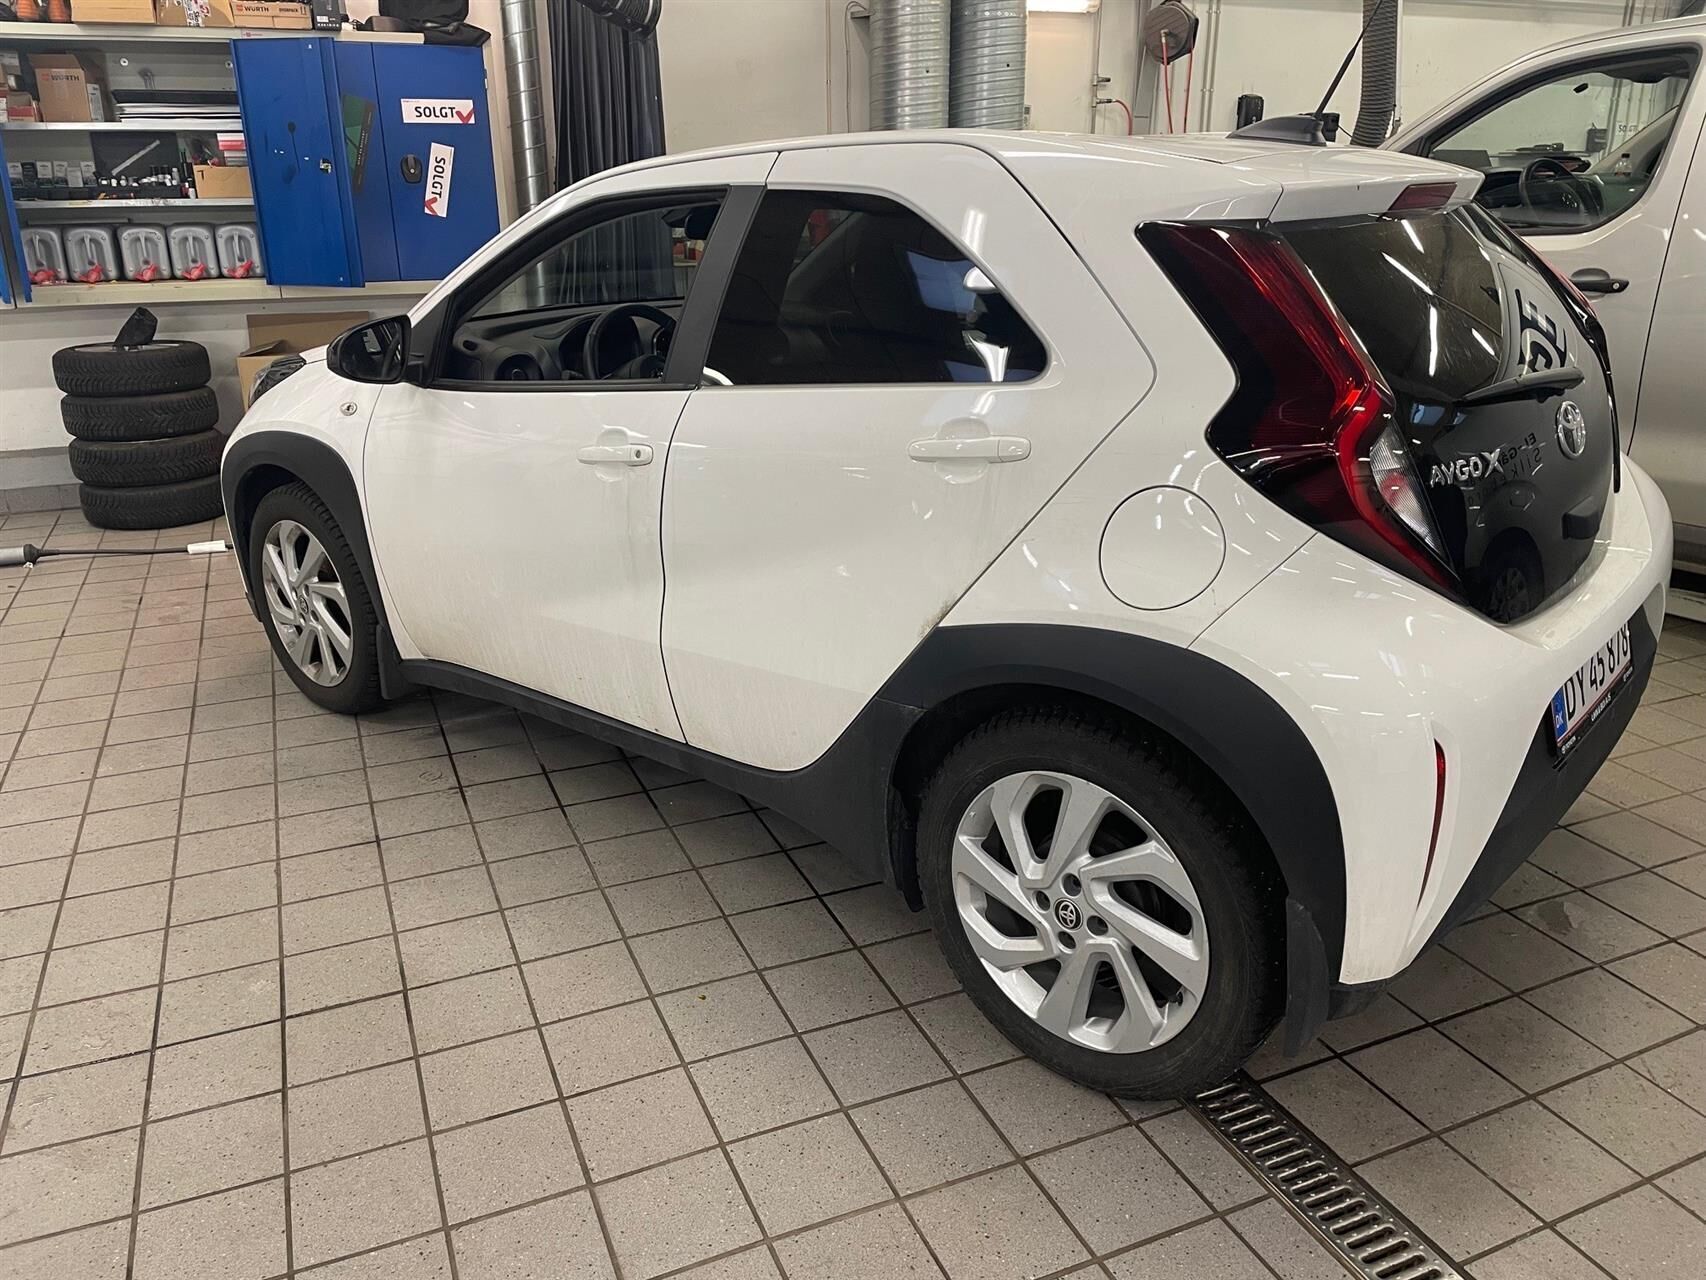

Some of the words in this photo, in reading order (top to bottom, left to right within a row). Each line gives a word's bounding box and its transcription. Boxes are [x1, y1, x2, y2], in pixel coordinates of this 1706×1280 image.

[414, 106, 456, 118] SOLGT
[431, 156, 446, 199] SOLGT
[1563, 666, 1586, 722] DY
[1589, 651, 1605, 691] 45
[1555, 710, 1564, 729] DK
